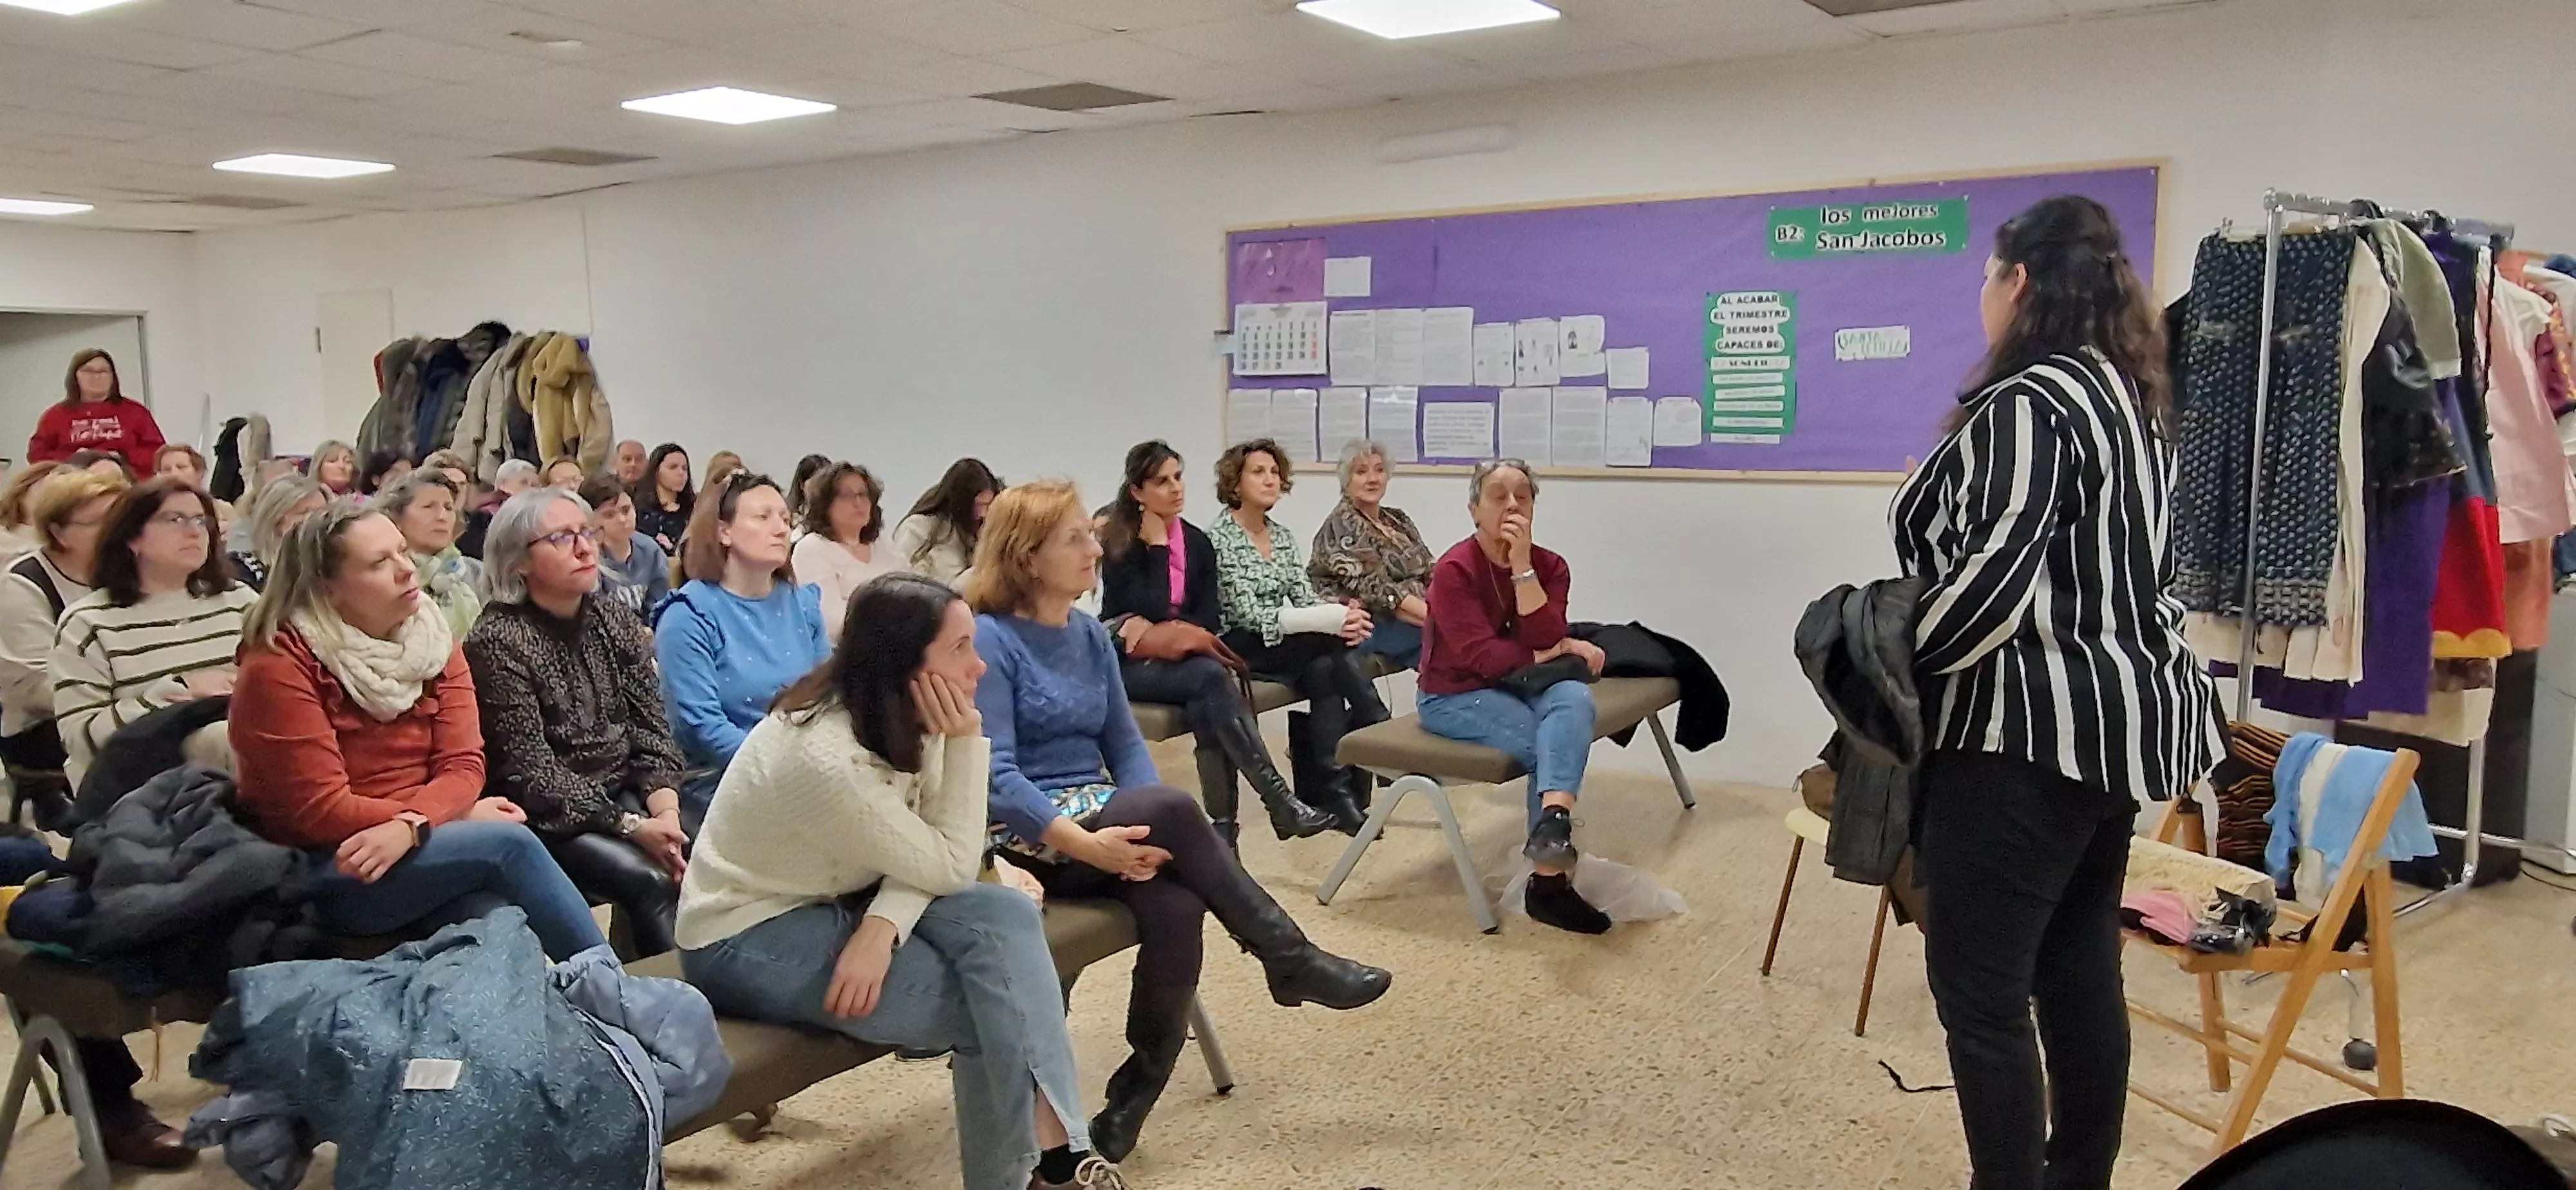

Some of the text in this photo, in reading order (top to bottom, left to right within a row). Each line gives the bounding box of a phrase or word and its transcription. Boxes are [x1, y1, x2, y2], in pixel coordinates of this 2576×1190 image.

[1821, 206, 1850, 224] los
[1817, 228, 1945, 249] San Jacobos
[1721, 296, 1732, 305] AL
[1713, 309, 1788, 320] EL TRIMESTRE
[1726, 325, 1774, 334] SEREMOS
[1718, 340, 1763, 350] CAPACES
